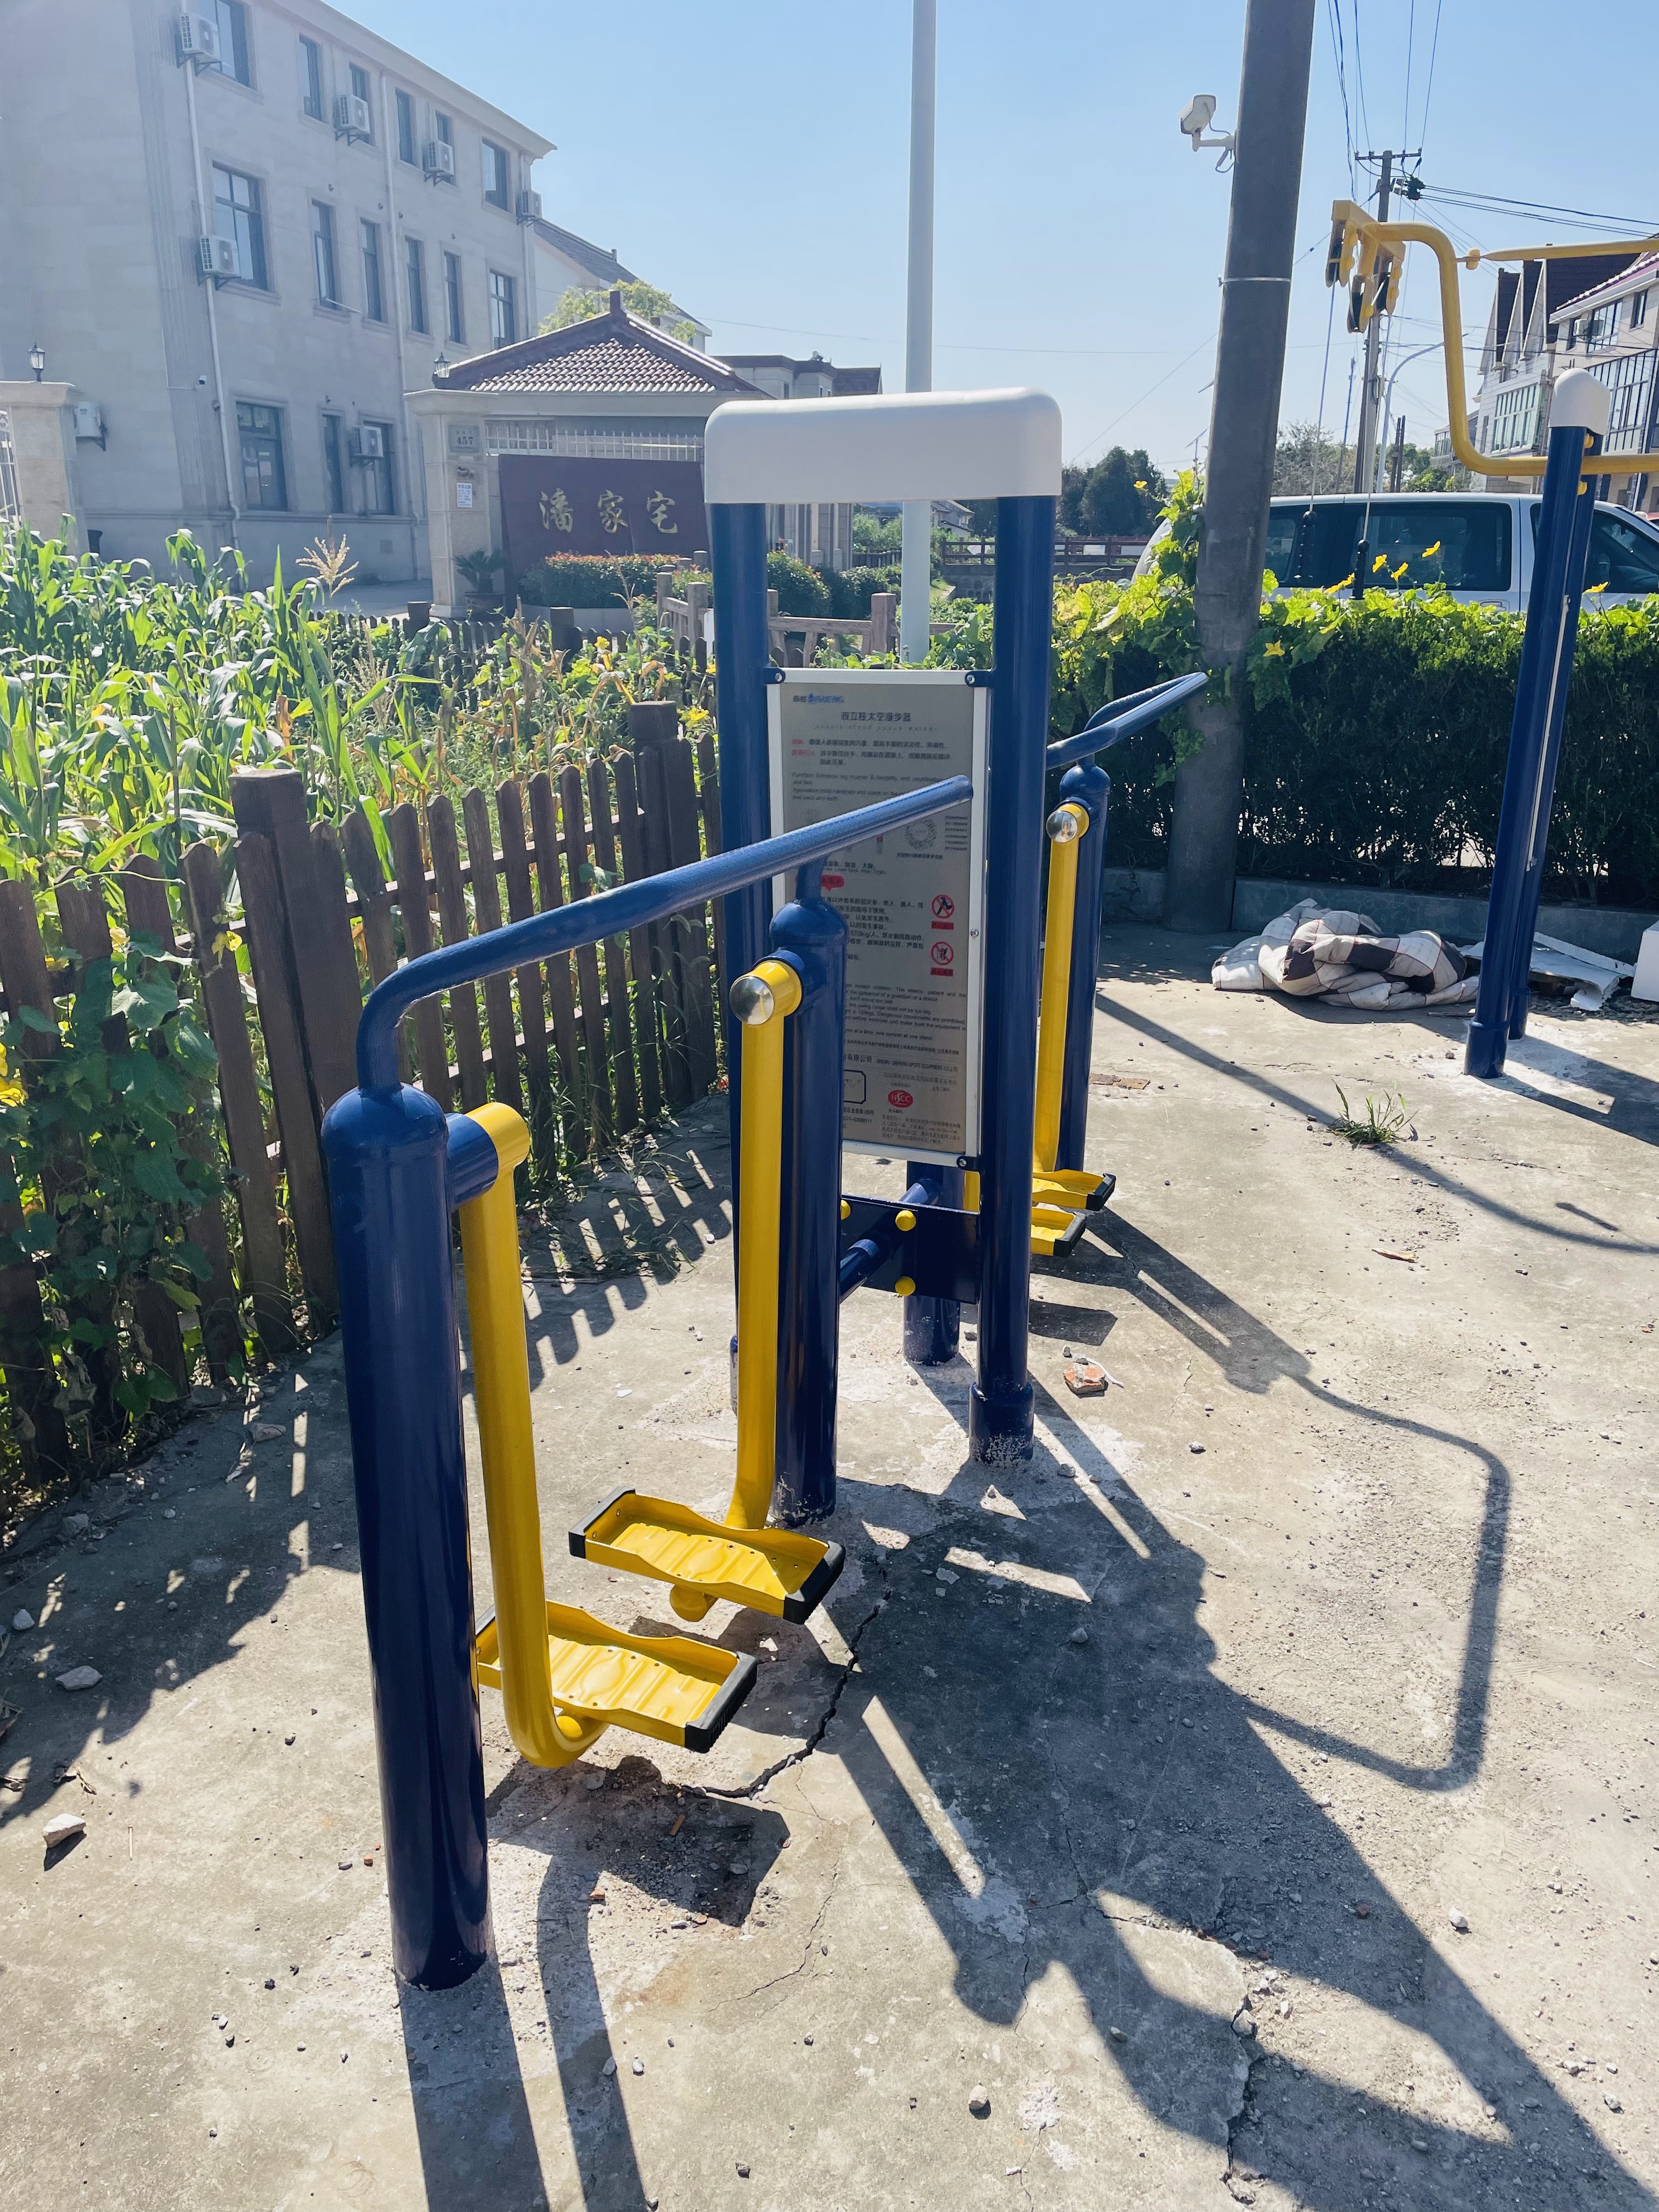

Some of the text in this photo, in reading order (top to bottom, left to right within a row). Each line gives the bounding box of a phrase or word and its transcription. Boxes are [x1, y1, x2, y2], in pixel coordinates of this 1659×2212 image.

[456, 436, 473, 445] 457
[539, 488, 678, 534] 潘家宅
